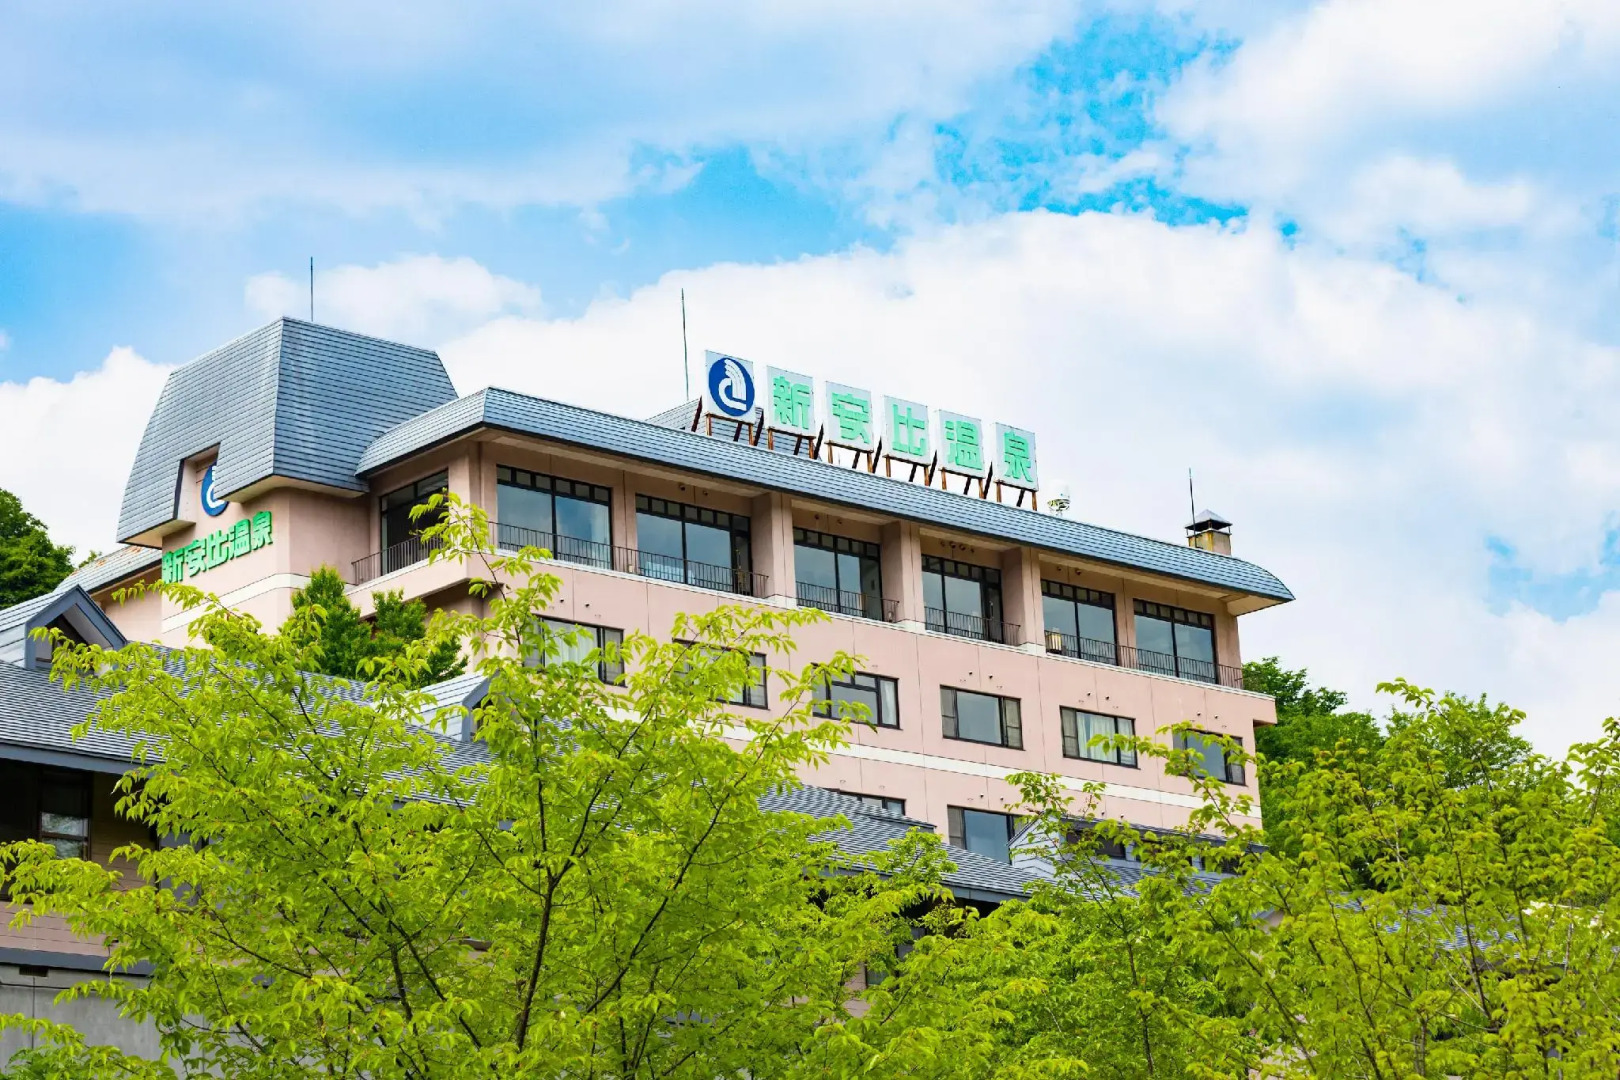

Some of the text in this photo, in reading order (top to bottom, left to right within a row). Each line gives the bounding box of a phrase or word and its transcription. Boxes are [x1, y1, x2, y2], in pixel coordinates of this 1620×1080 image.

[773, 376, 1033, 482] 新安比温泉
[161, 511, 273, 584] 新安比温泉
